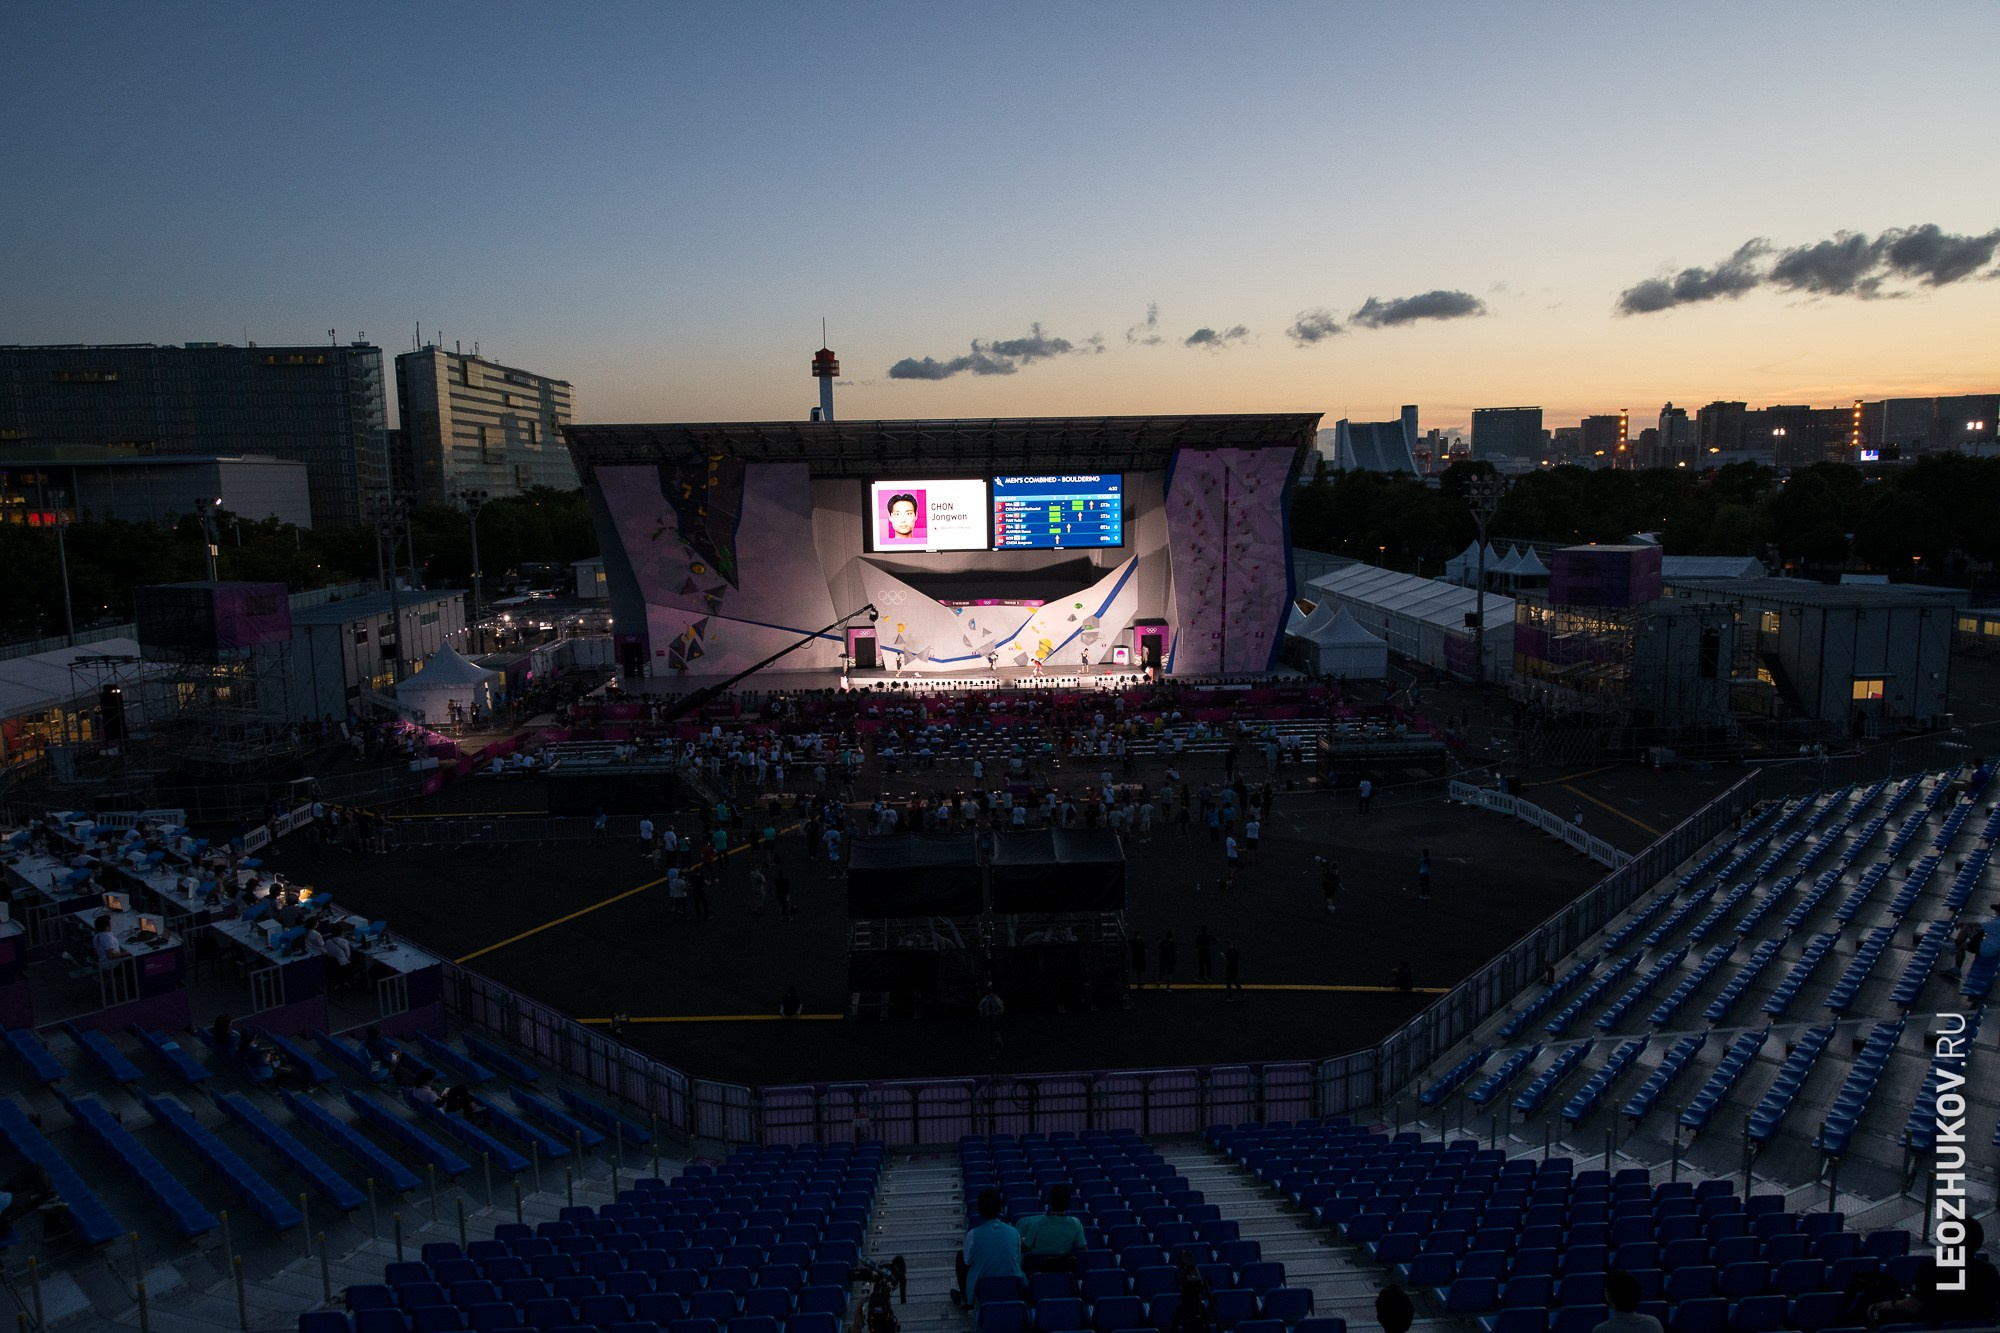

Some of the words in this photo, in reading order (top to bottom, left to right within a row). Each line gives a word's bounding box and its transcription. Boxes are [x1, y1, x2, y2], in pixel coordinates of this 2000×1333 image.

[1024, 476, 1057, 484] COMBINED
[1061, 475, 1101, 483] BOULDERING
[931, 502, 954, 511] CHON
